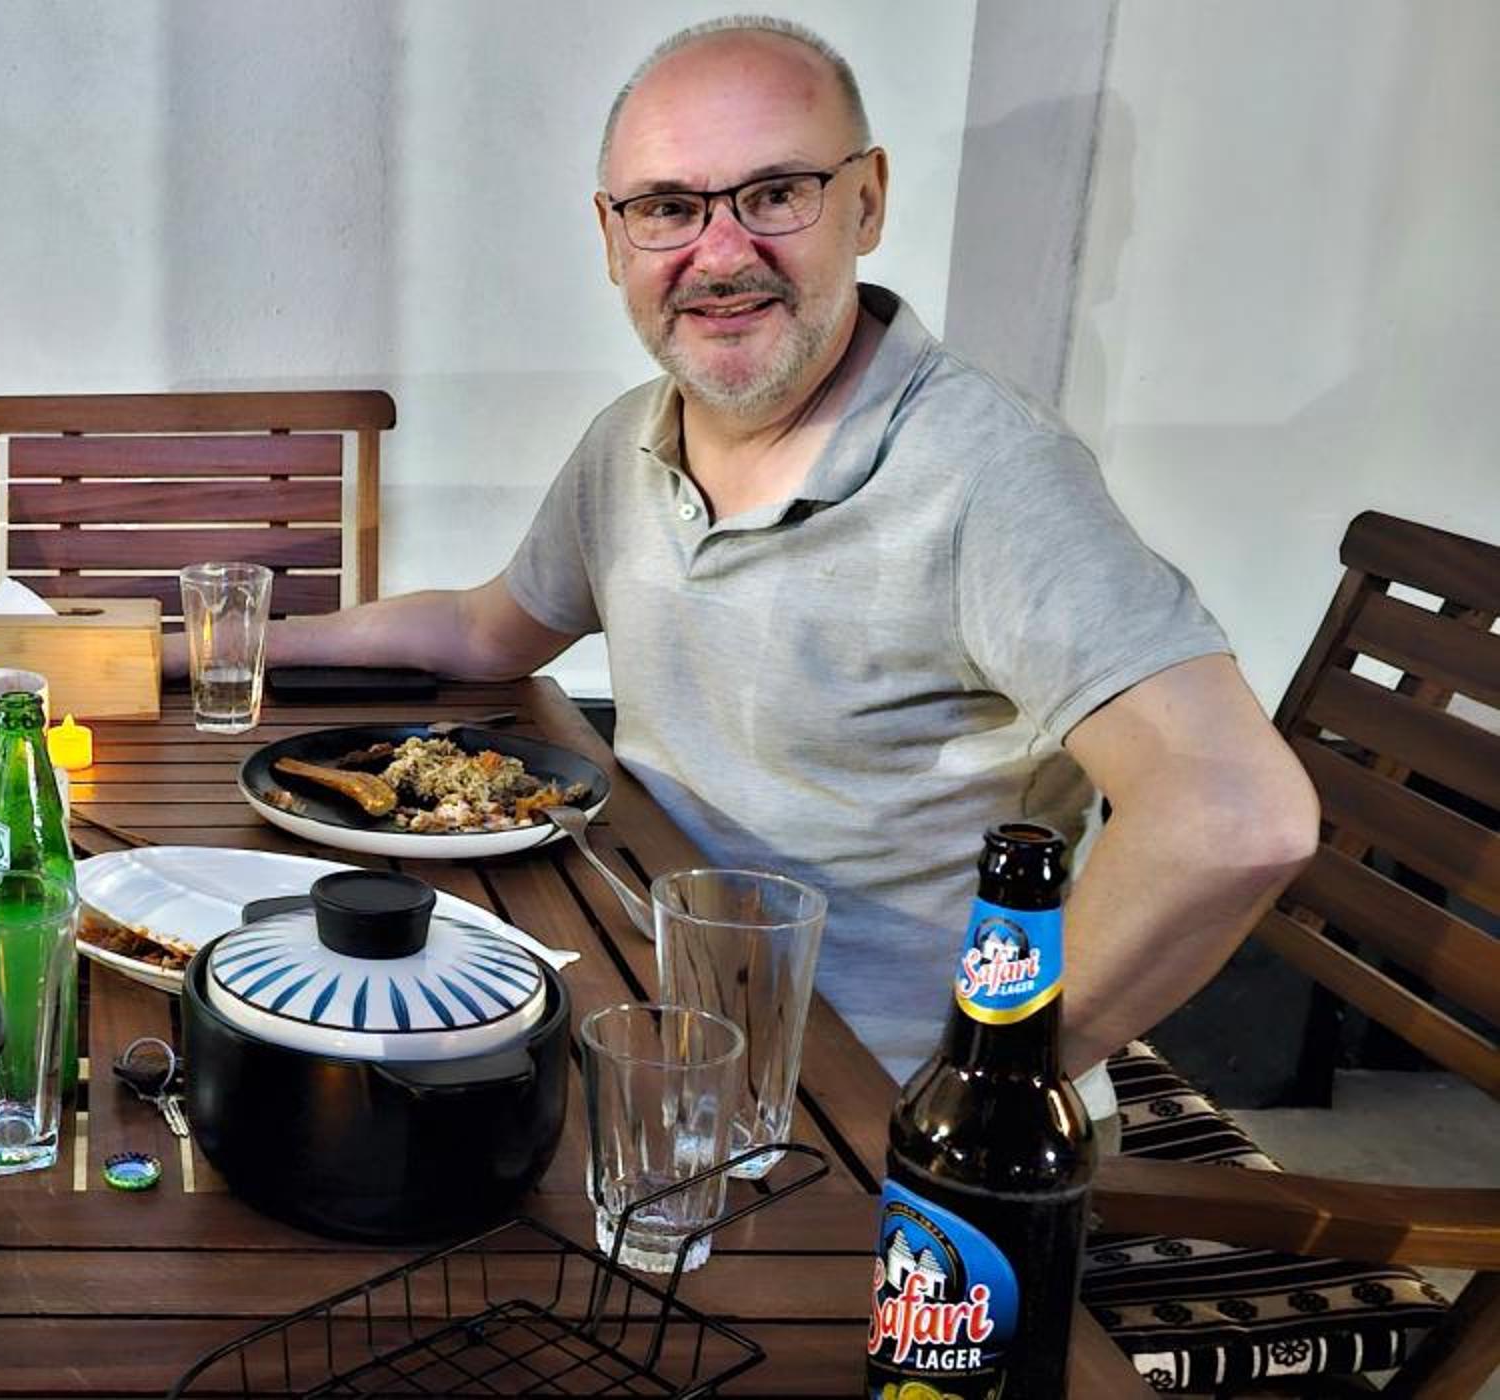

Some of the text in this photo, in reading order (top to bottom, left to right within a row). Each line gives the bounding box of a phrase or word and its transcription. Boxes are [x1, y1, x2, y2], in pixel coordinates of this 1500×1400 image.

[959, 947, 1041, 999] Safari
[1001, 980, 1035, 996] LAGER
[867, 1256, 994, 1364] Safari
[915, 1348, 982, 1370] LAGER
